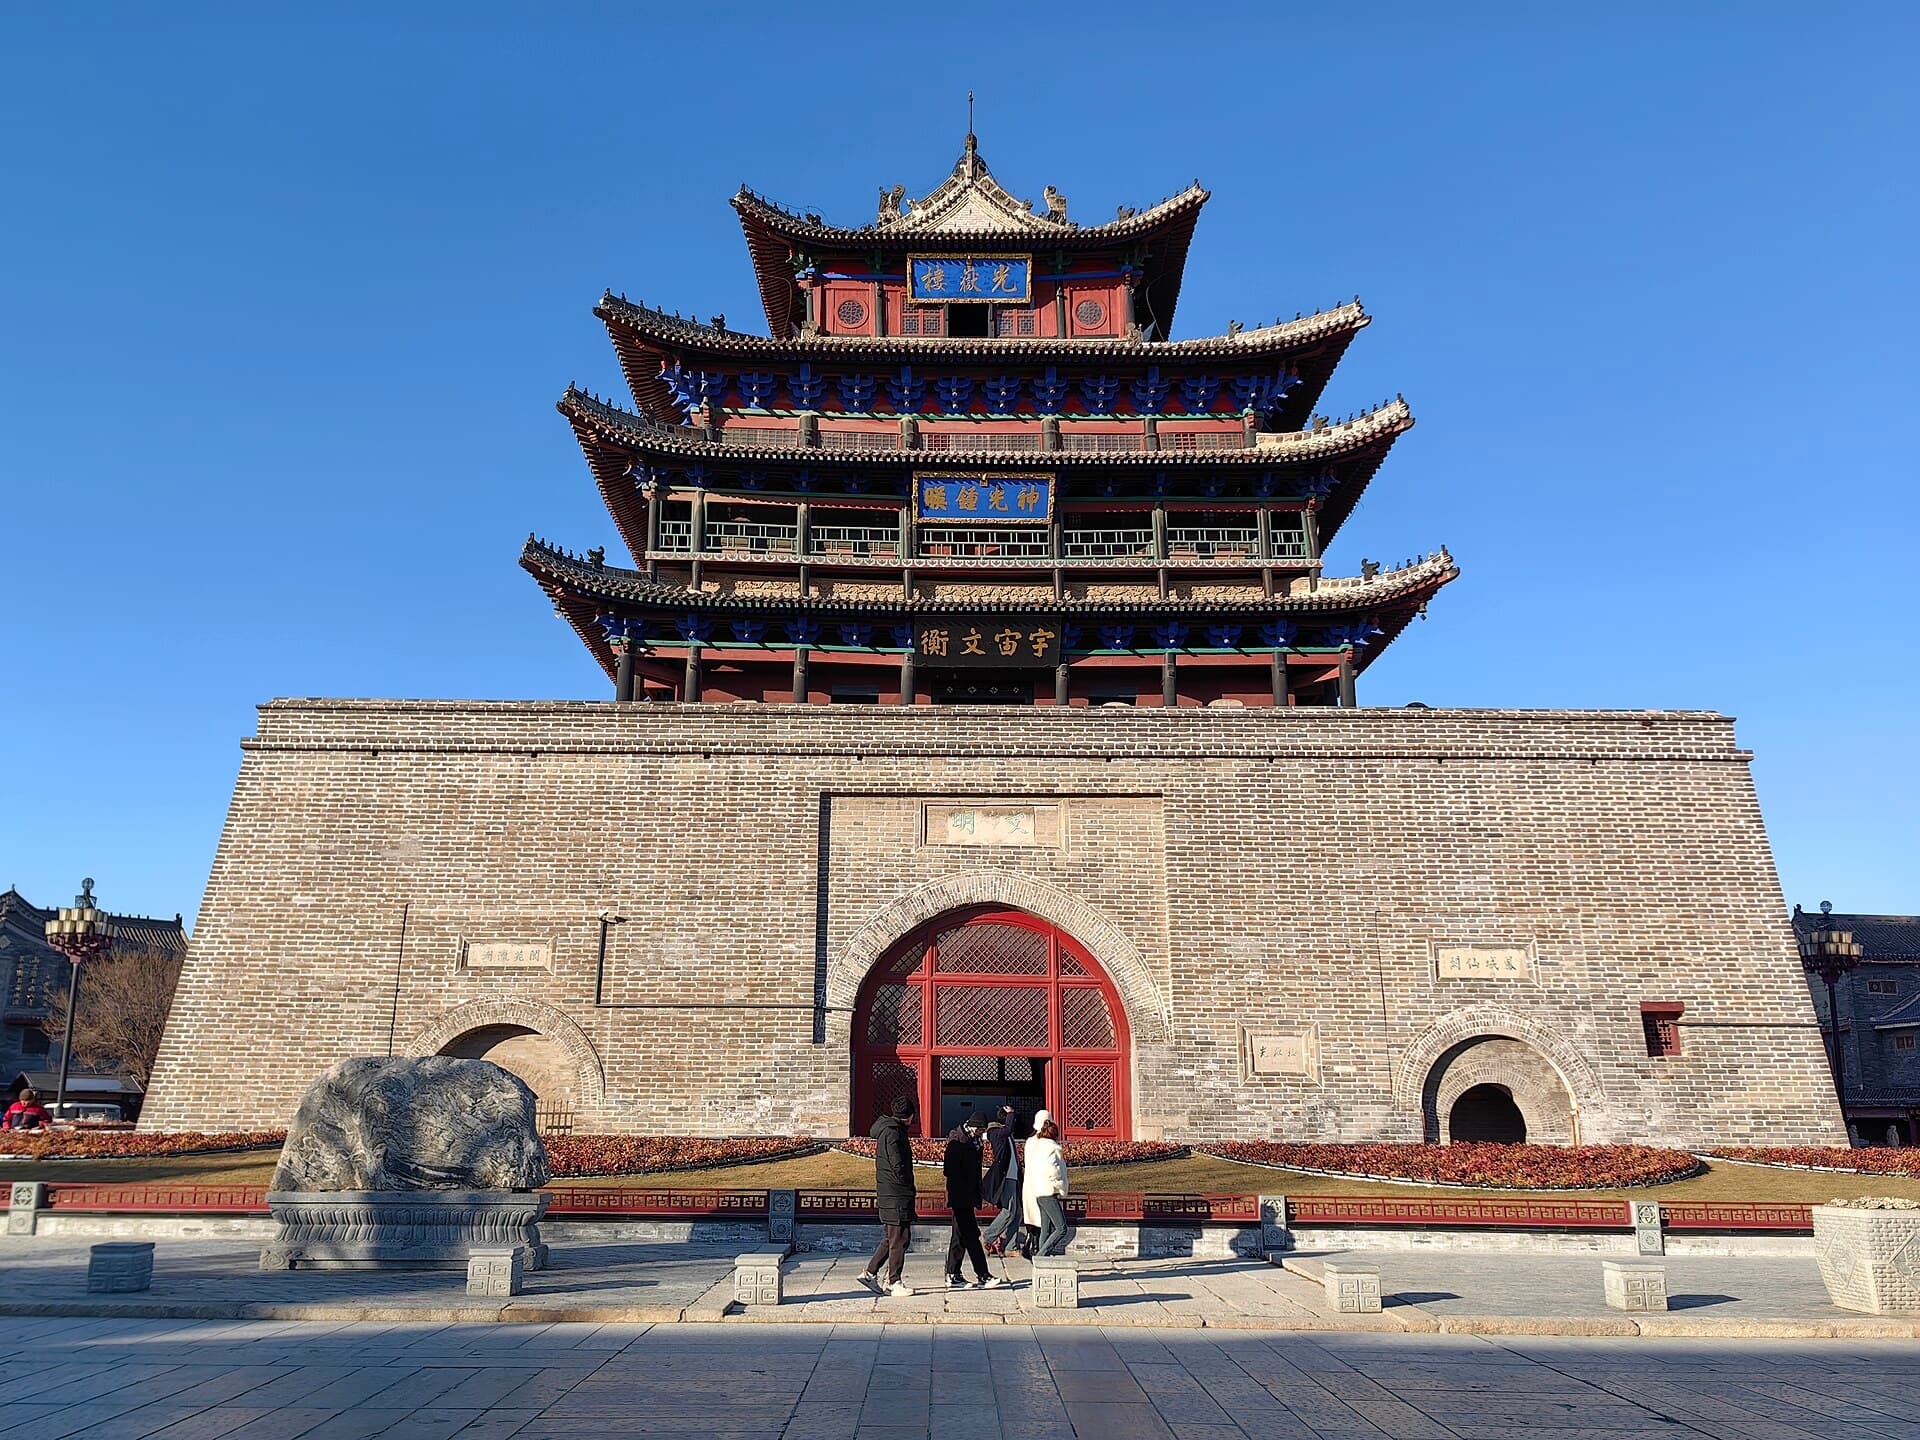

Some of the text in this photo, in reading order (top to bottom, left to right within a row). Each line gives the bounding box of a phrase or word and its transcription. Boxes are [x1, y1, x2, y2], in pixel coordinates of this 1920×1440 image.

[920, 627, 1056, 657] 宇宙文衡
[951, 809, 1029, 835] 文明
